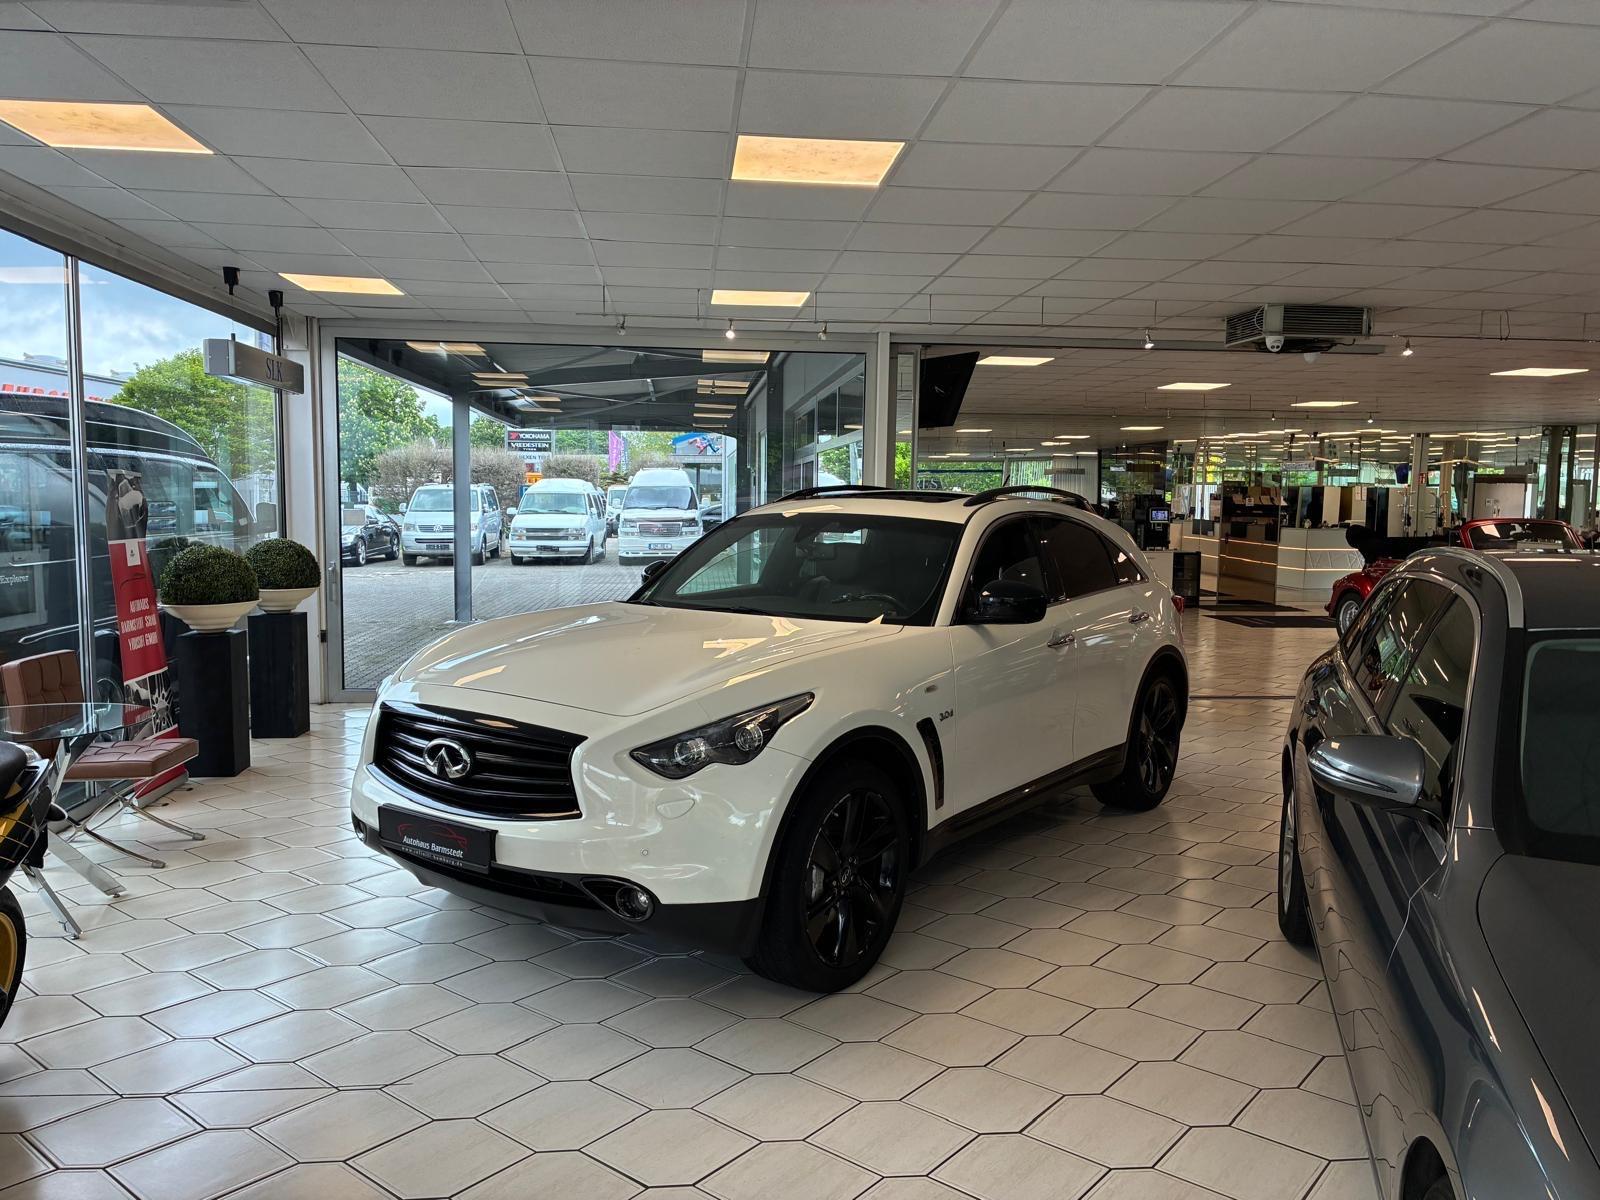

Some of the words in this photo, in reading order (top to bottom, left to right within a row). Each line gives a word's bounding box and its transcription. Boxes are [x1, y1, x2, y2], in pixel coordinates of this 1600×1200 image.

[265, 357, 283, 382] SLK
[518, 432, 550, 440] YOKOHAMA
[403, 836, 430, 850] Autohaus
[431, 843, 463, 858] Barmstedt
